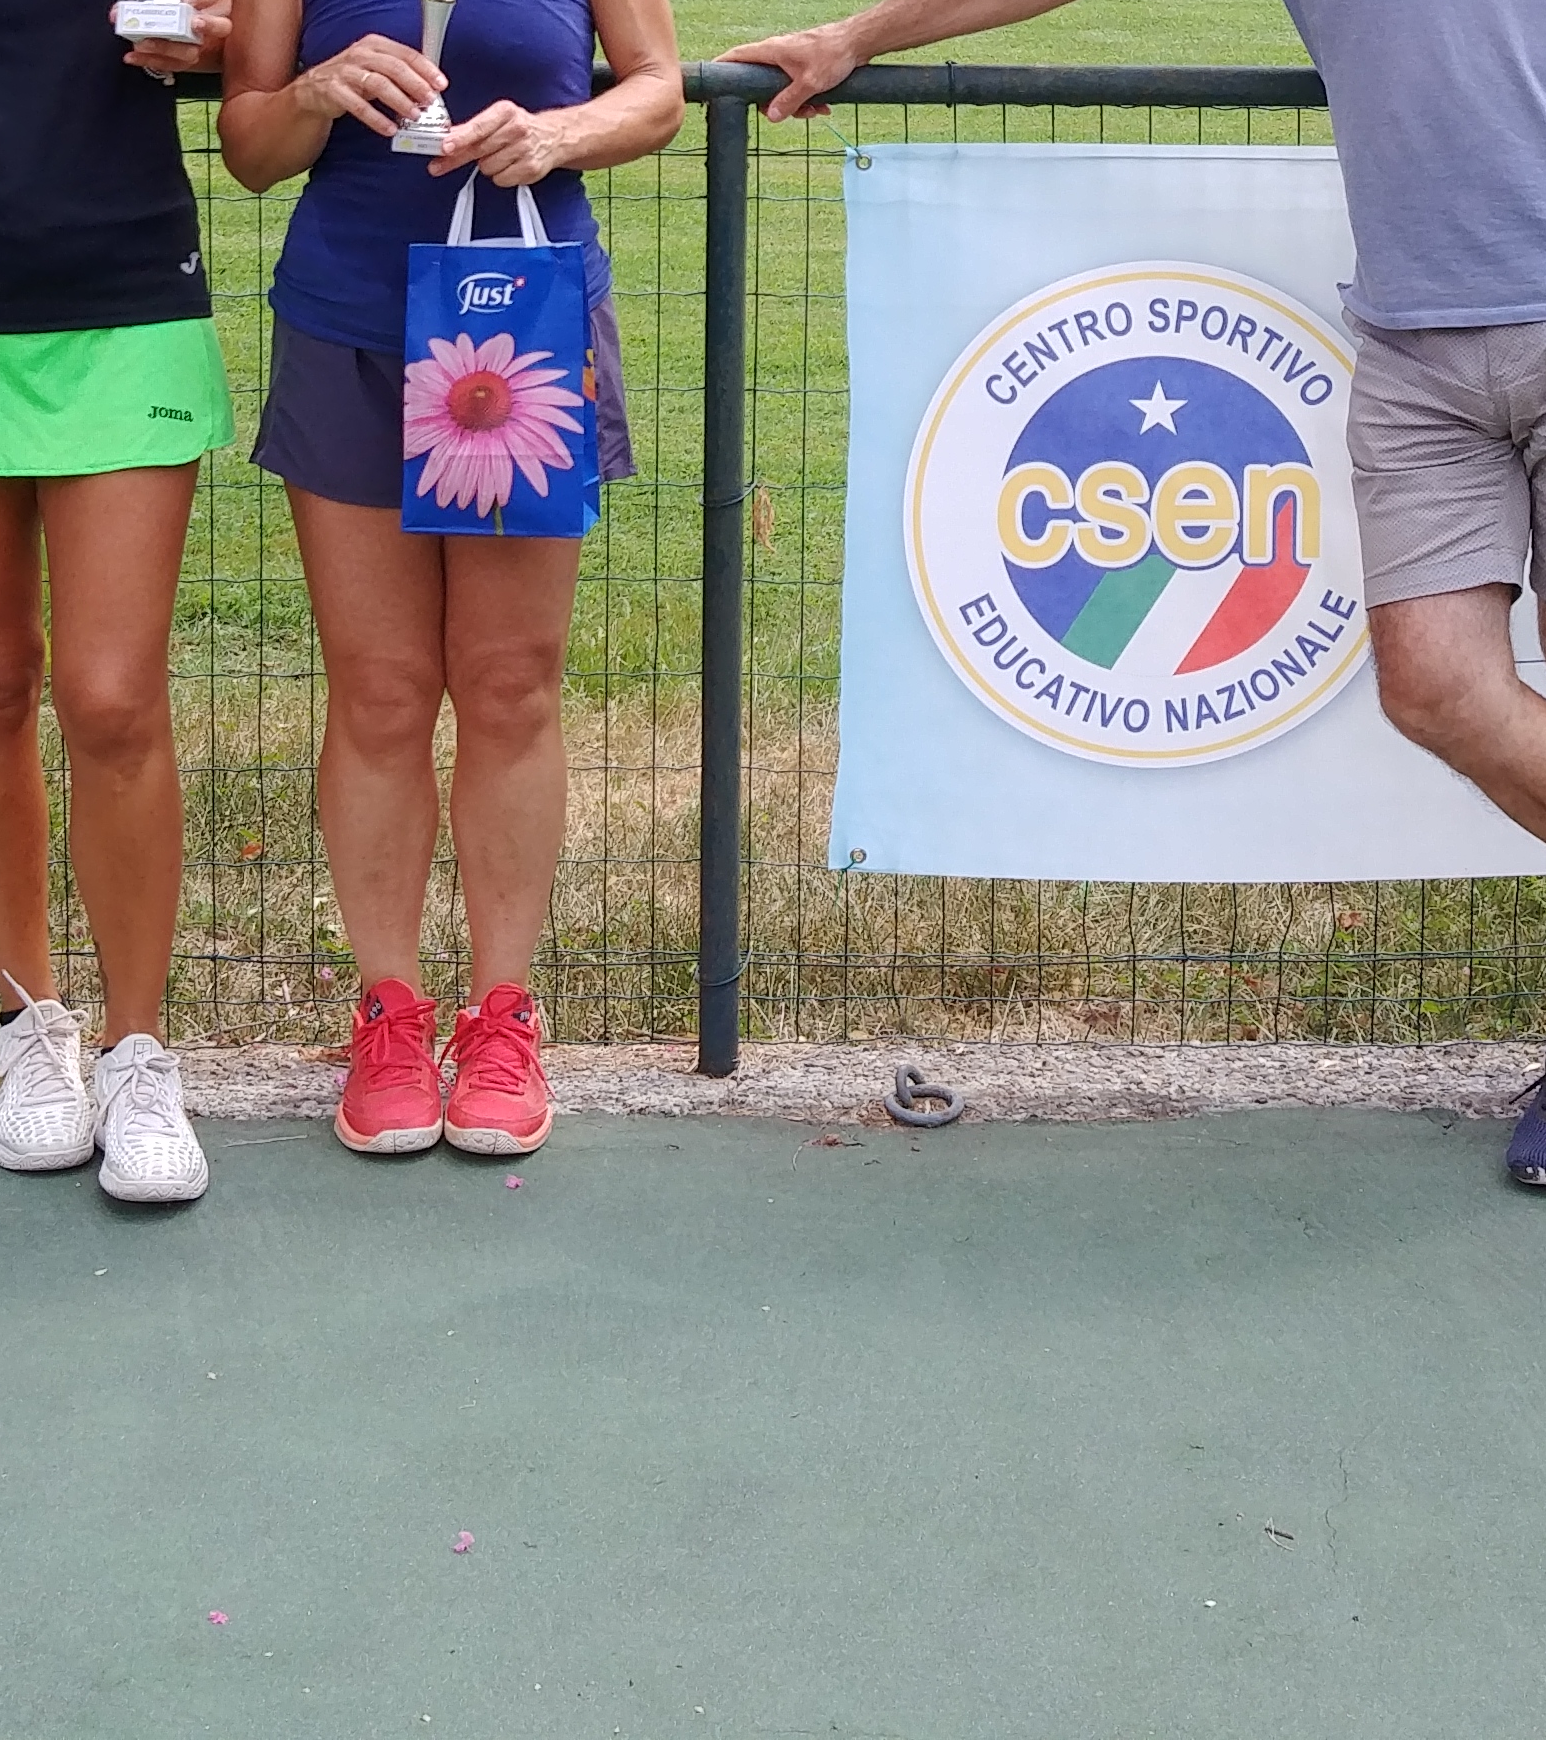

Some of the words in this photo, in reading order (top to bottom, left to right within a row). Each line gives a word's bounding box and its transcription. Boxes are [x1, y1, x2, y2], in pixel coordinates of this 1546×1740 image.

[458, 281, 516, 315] Just
[985, 301, 1133, 405] CENTRO
[1147, 297, 1334, 407] SPORTIVO
[996, 463, 1322, 567] csen
[959, 593, 1150, 733] EDUCATIVO
[1165, 589, 1357, 733] NAZIONALE
